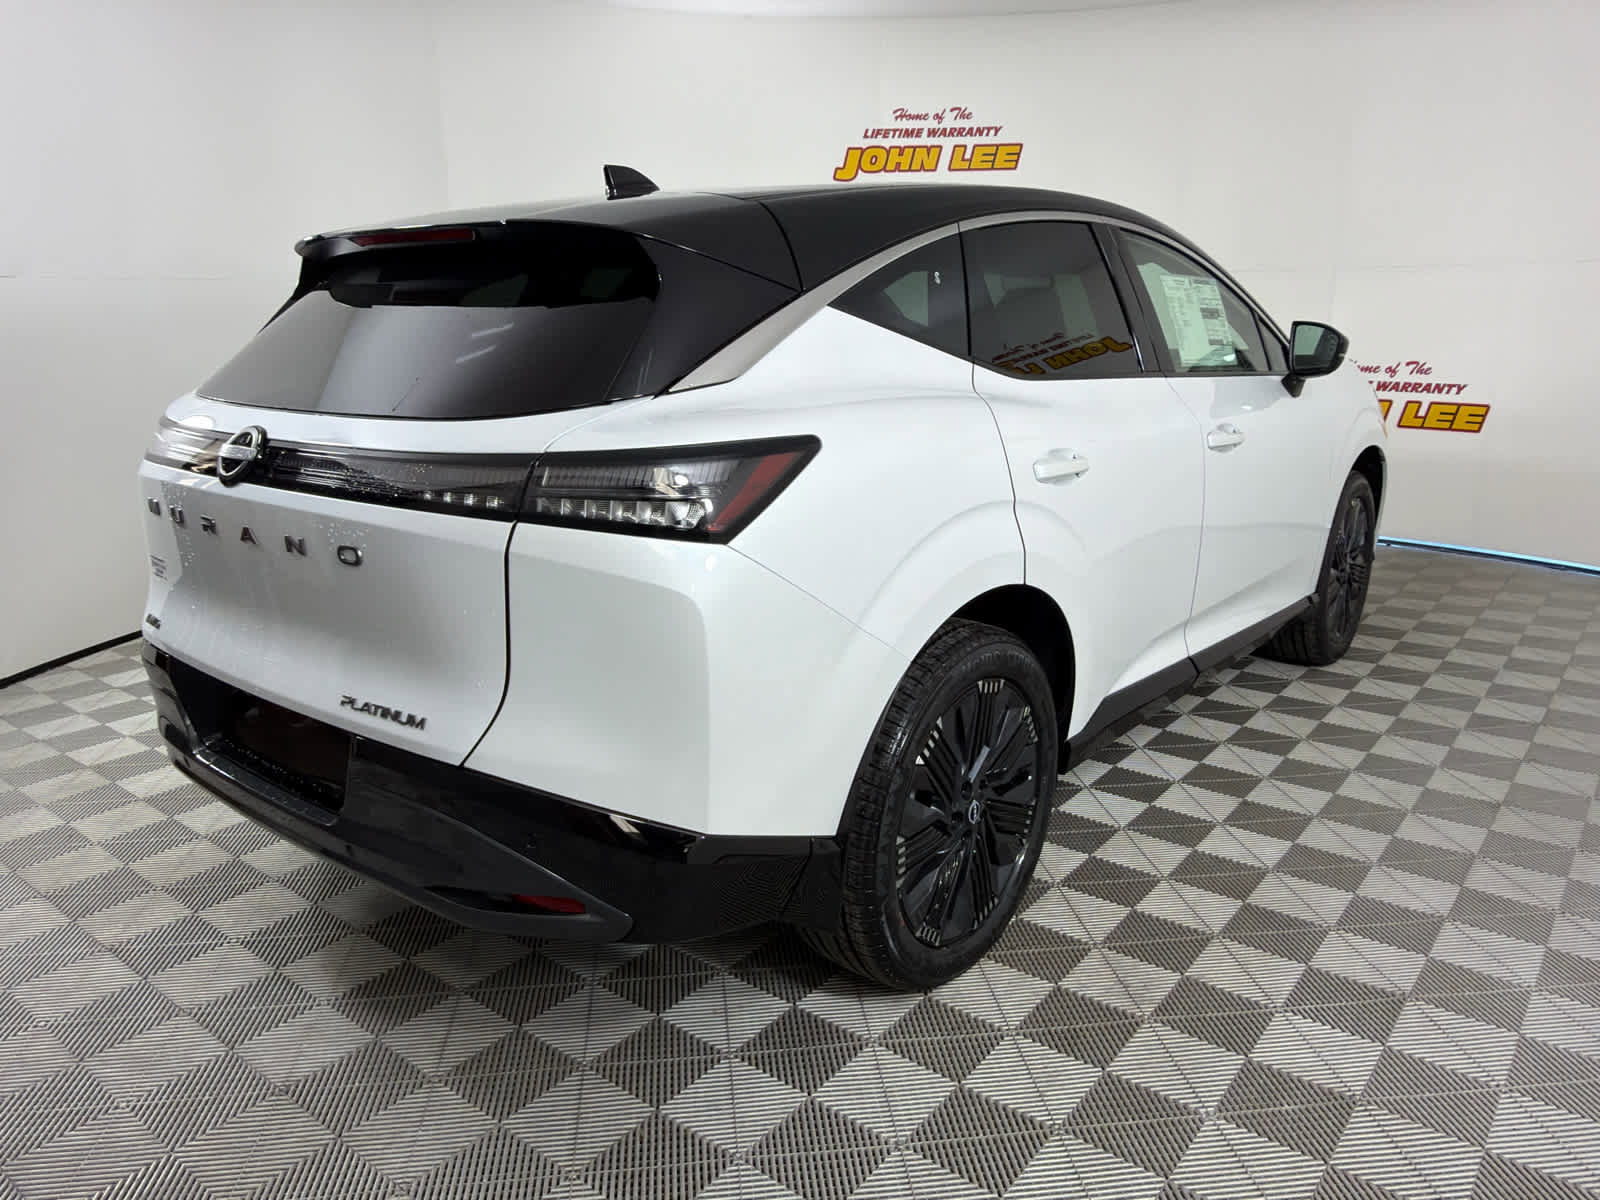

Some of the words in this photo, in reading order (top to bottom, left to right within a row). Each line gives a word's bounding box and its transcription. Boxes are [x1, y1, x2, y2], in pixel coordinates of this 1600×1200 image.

[893, 107, 929, 121] Home
[933, 109, 946, 124] of
[950, 107, 973, 120] The
[863, 128, 924, 139] LIFETIME
[926, 126, 1003, 138] WARRANTY
[833, 144, 942, 181] JOHN
[948, 143, 1023, 171] LEE
[1385, 361, 1400, 378] of
[1405, 361, 1432, 375] The
[1376, 381, 1467, 395] WARRANTY
[1397, 400, 1491, 433] LEE
[340, 695, 427, 730] PLATINUM
